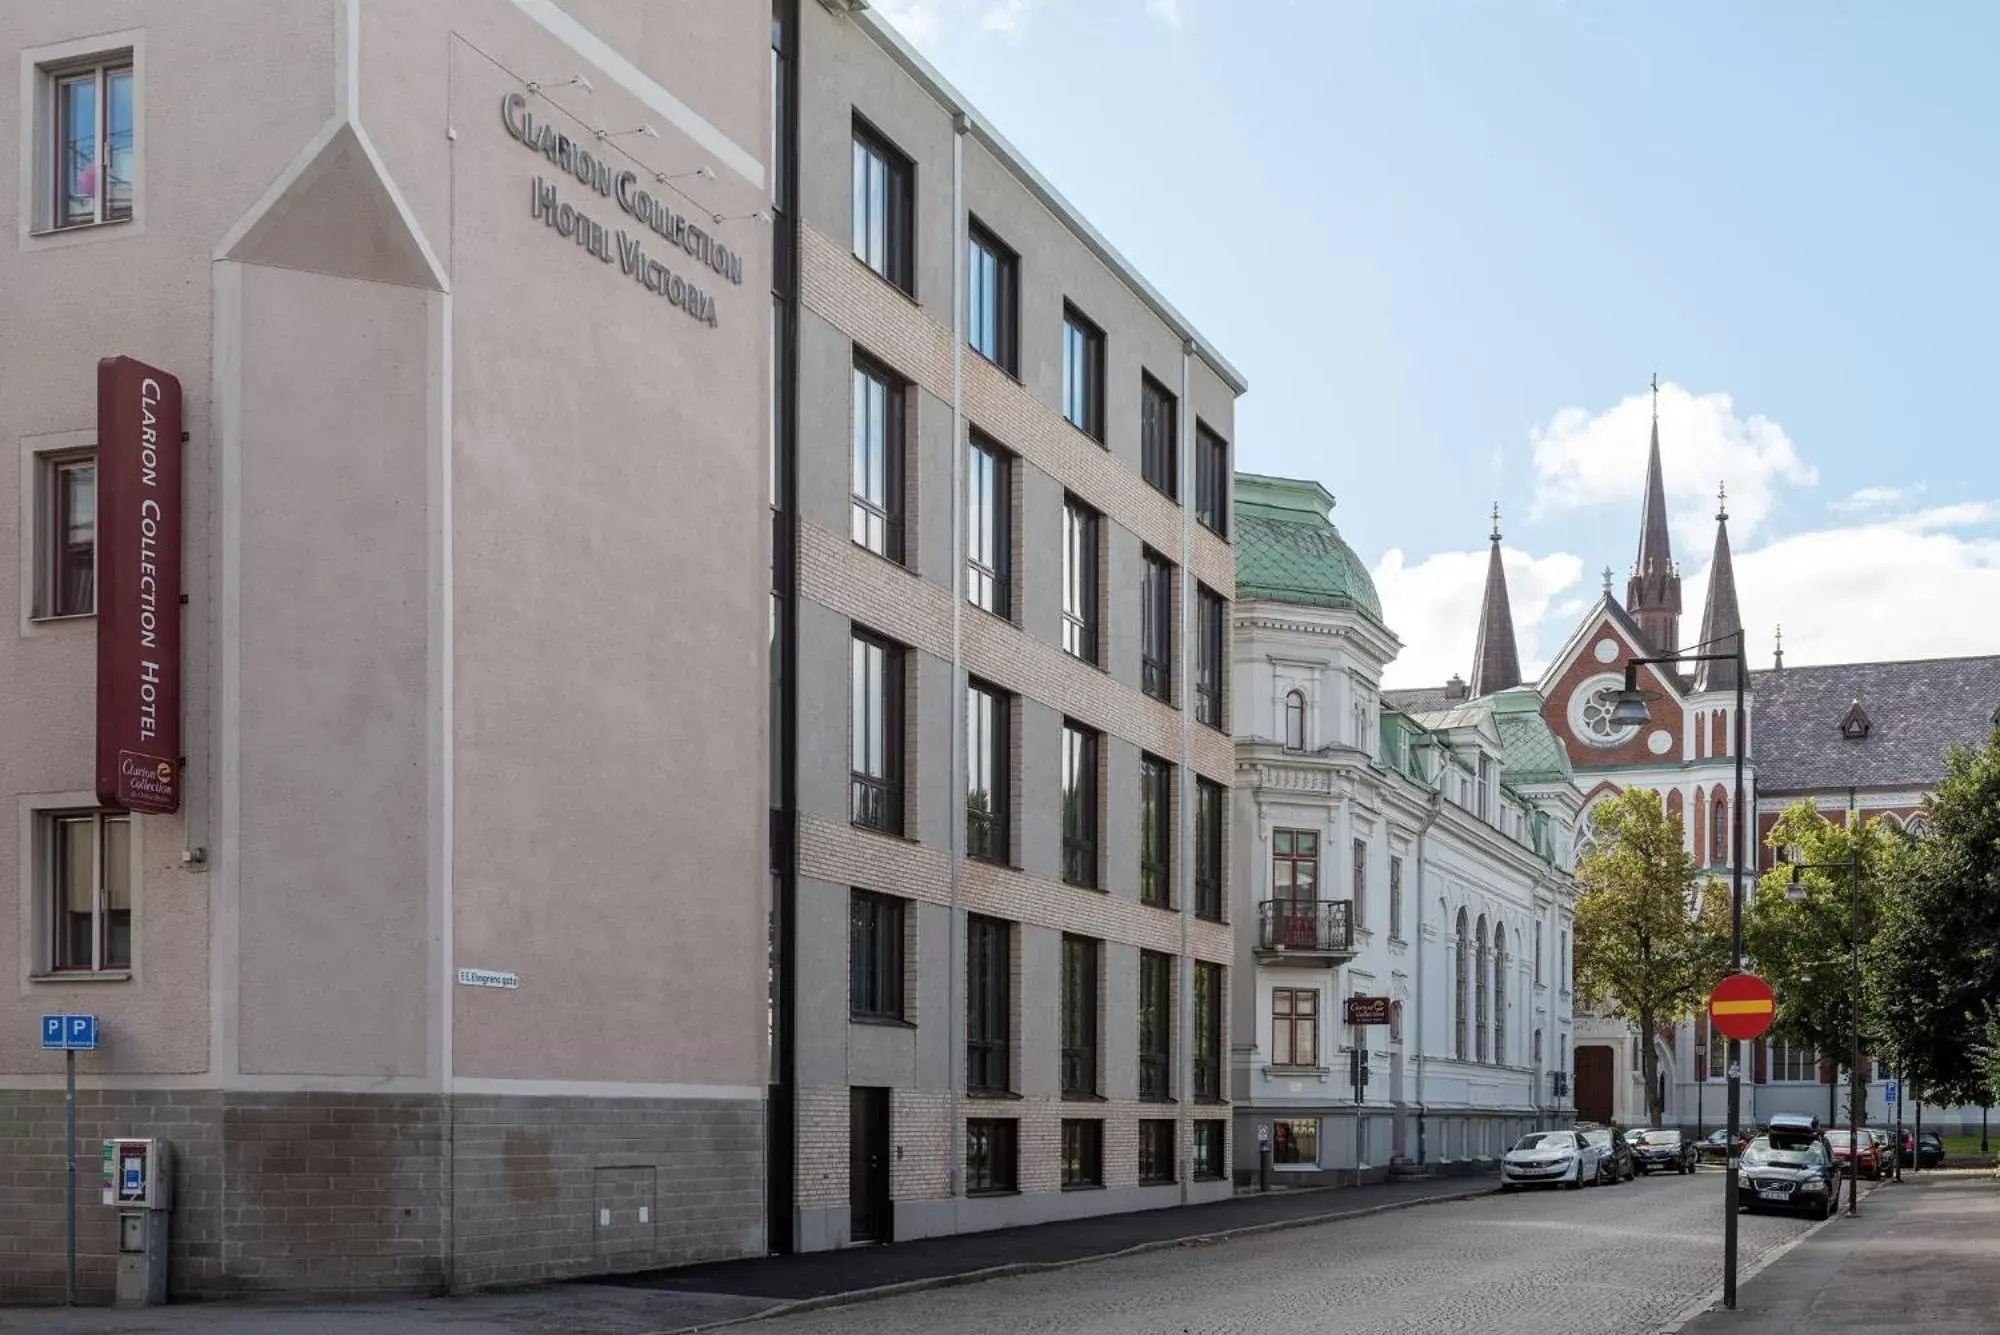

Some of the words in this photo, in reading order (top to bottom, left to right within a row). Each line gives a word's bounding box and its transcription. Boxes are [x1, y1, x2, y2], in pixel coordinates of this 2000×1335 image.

[502, 92, 612, 198] CLARION
[615, 170, 742, 285] COLLECTION
[532, 175, 614, 264] HOTEL
[617, 229, 717, 329] VICTORIA
[141, 378, 161, 486] CLARION
[141, 499, 161, 648] COLLECTION
[140, 660, 160, 742] HOTEL
[130, 777, 172, 795] Collection
[48, 1019, 59, 1036] P
[73, 1019, 86, 1036] P
